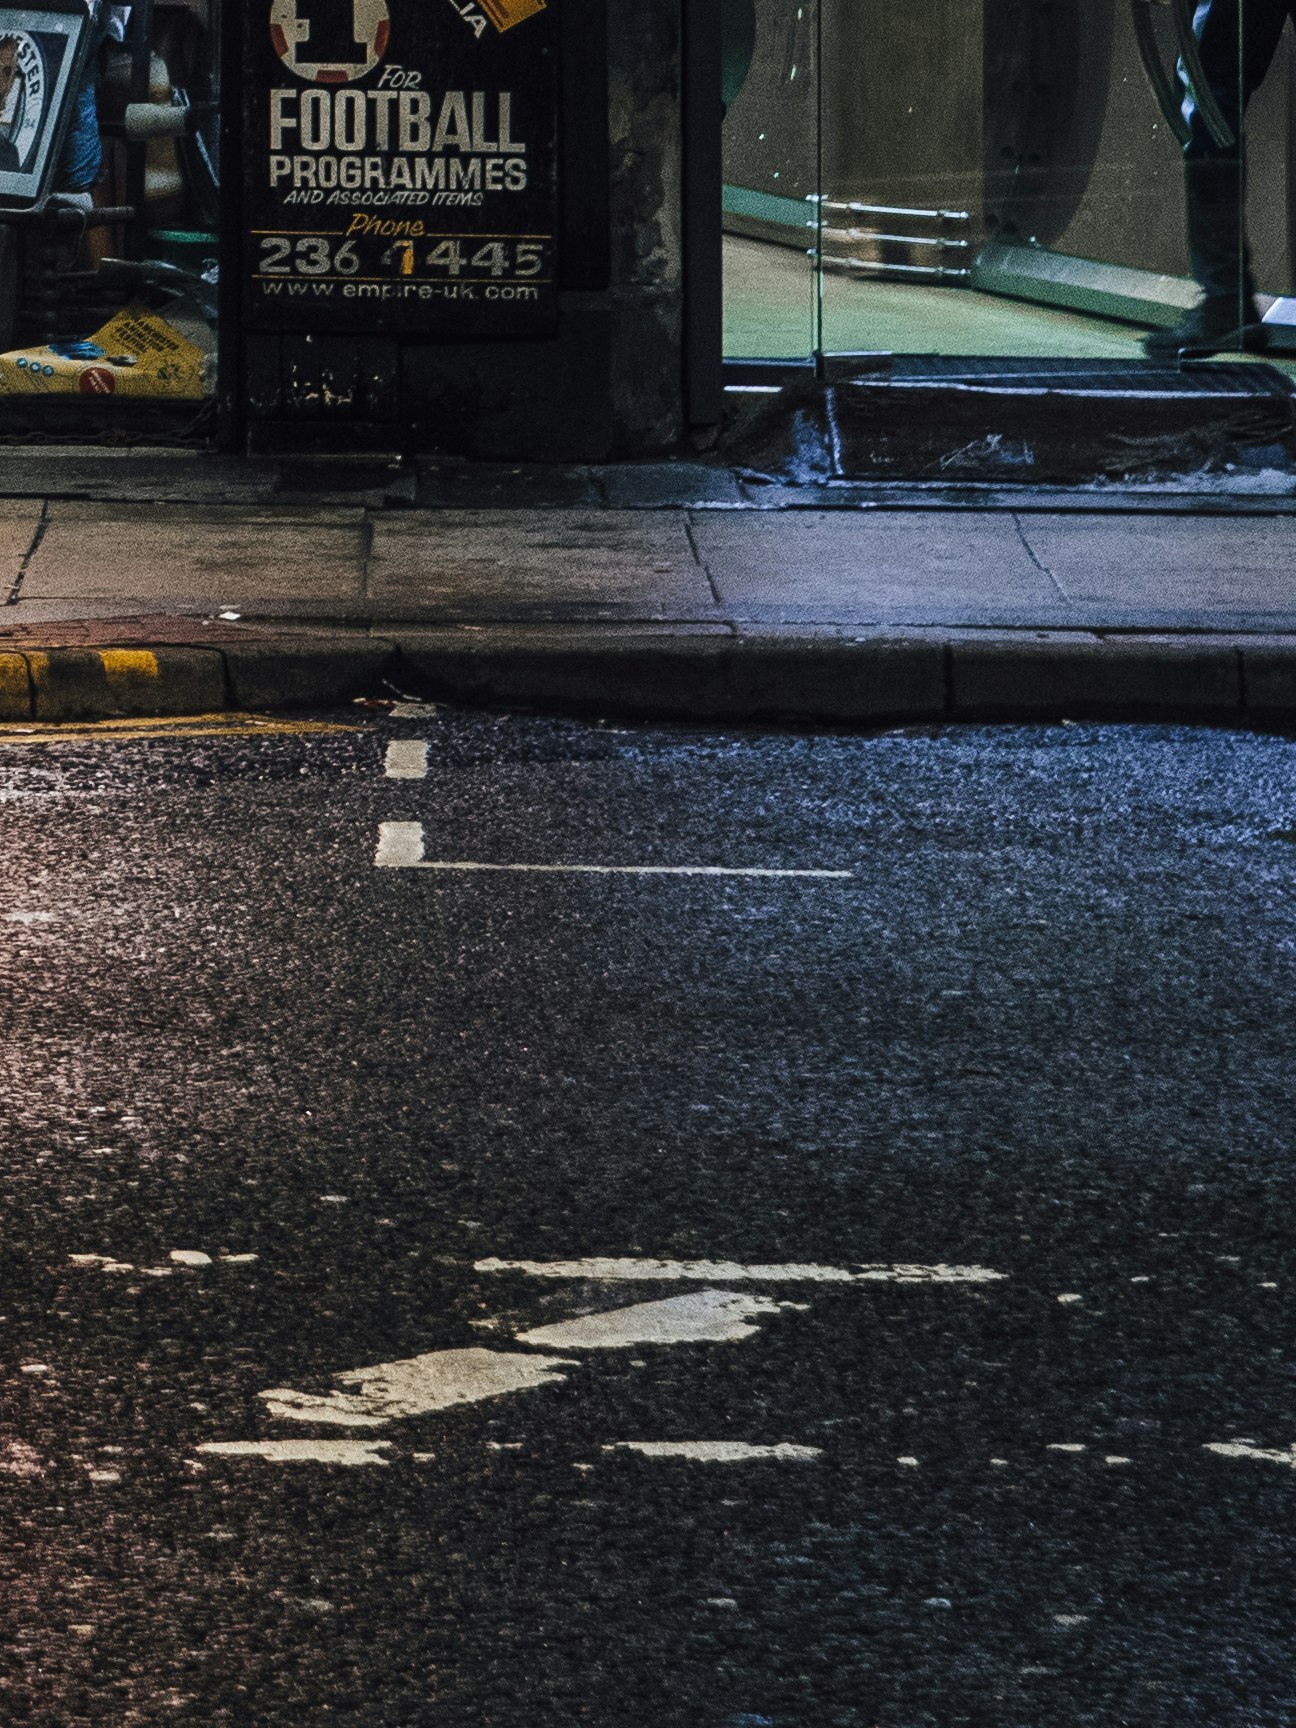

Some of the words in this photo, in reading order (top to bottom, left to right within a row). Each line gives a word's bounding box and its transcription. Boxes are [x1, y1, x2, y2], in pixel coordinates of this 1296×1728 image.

[377, 64, 422, 90] FOR
[269, 89, 526, 153] FOOTBALL
[269, 155, 527, 191] PROGRAMMES
[283, 191, 324, 205] AND
[326, 191, 429, 206] ASSOCIATED
[432, 191, 485, 206] ITEMS
[345, 212, 426, 237] Phone
[259, 237, 360, 275] 236
